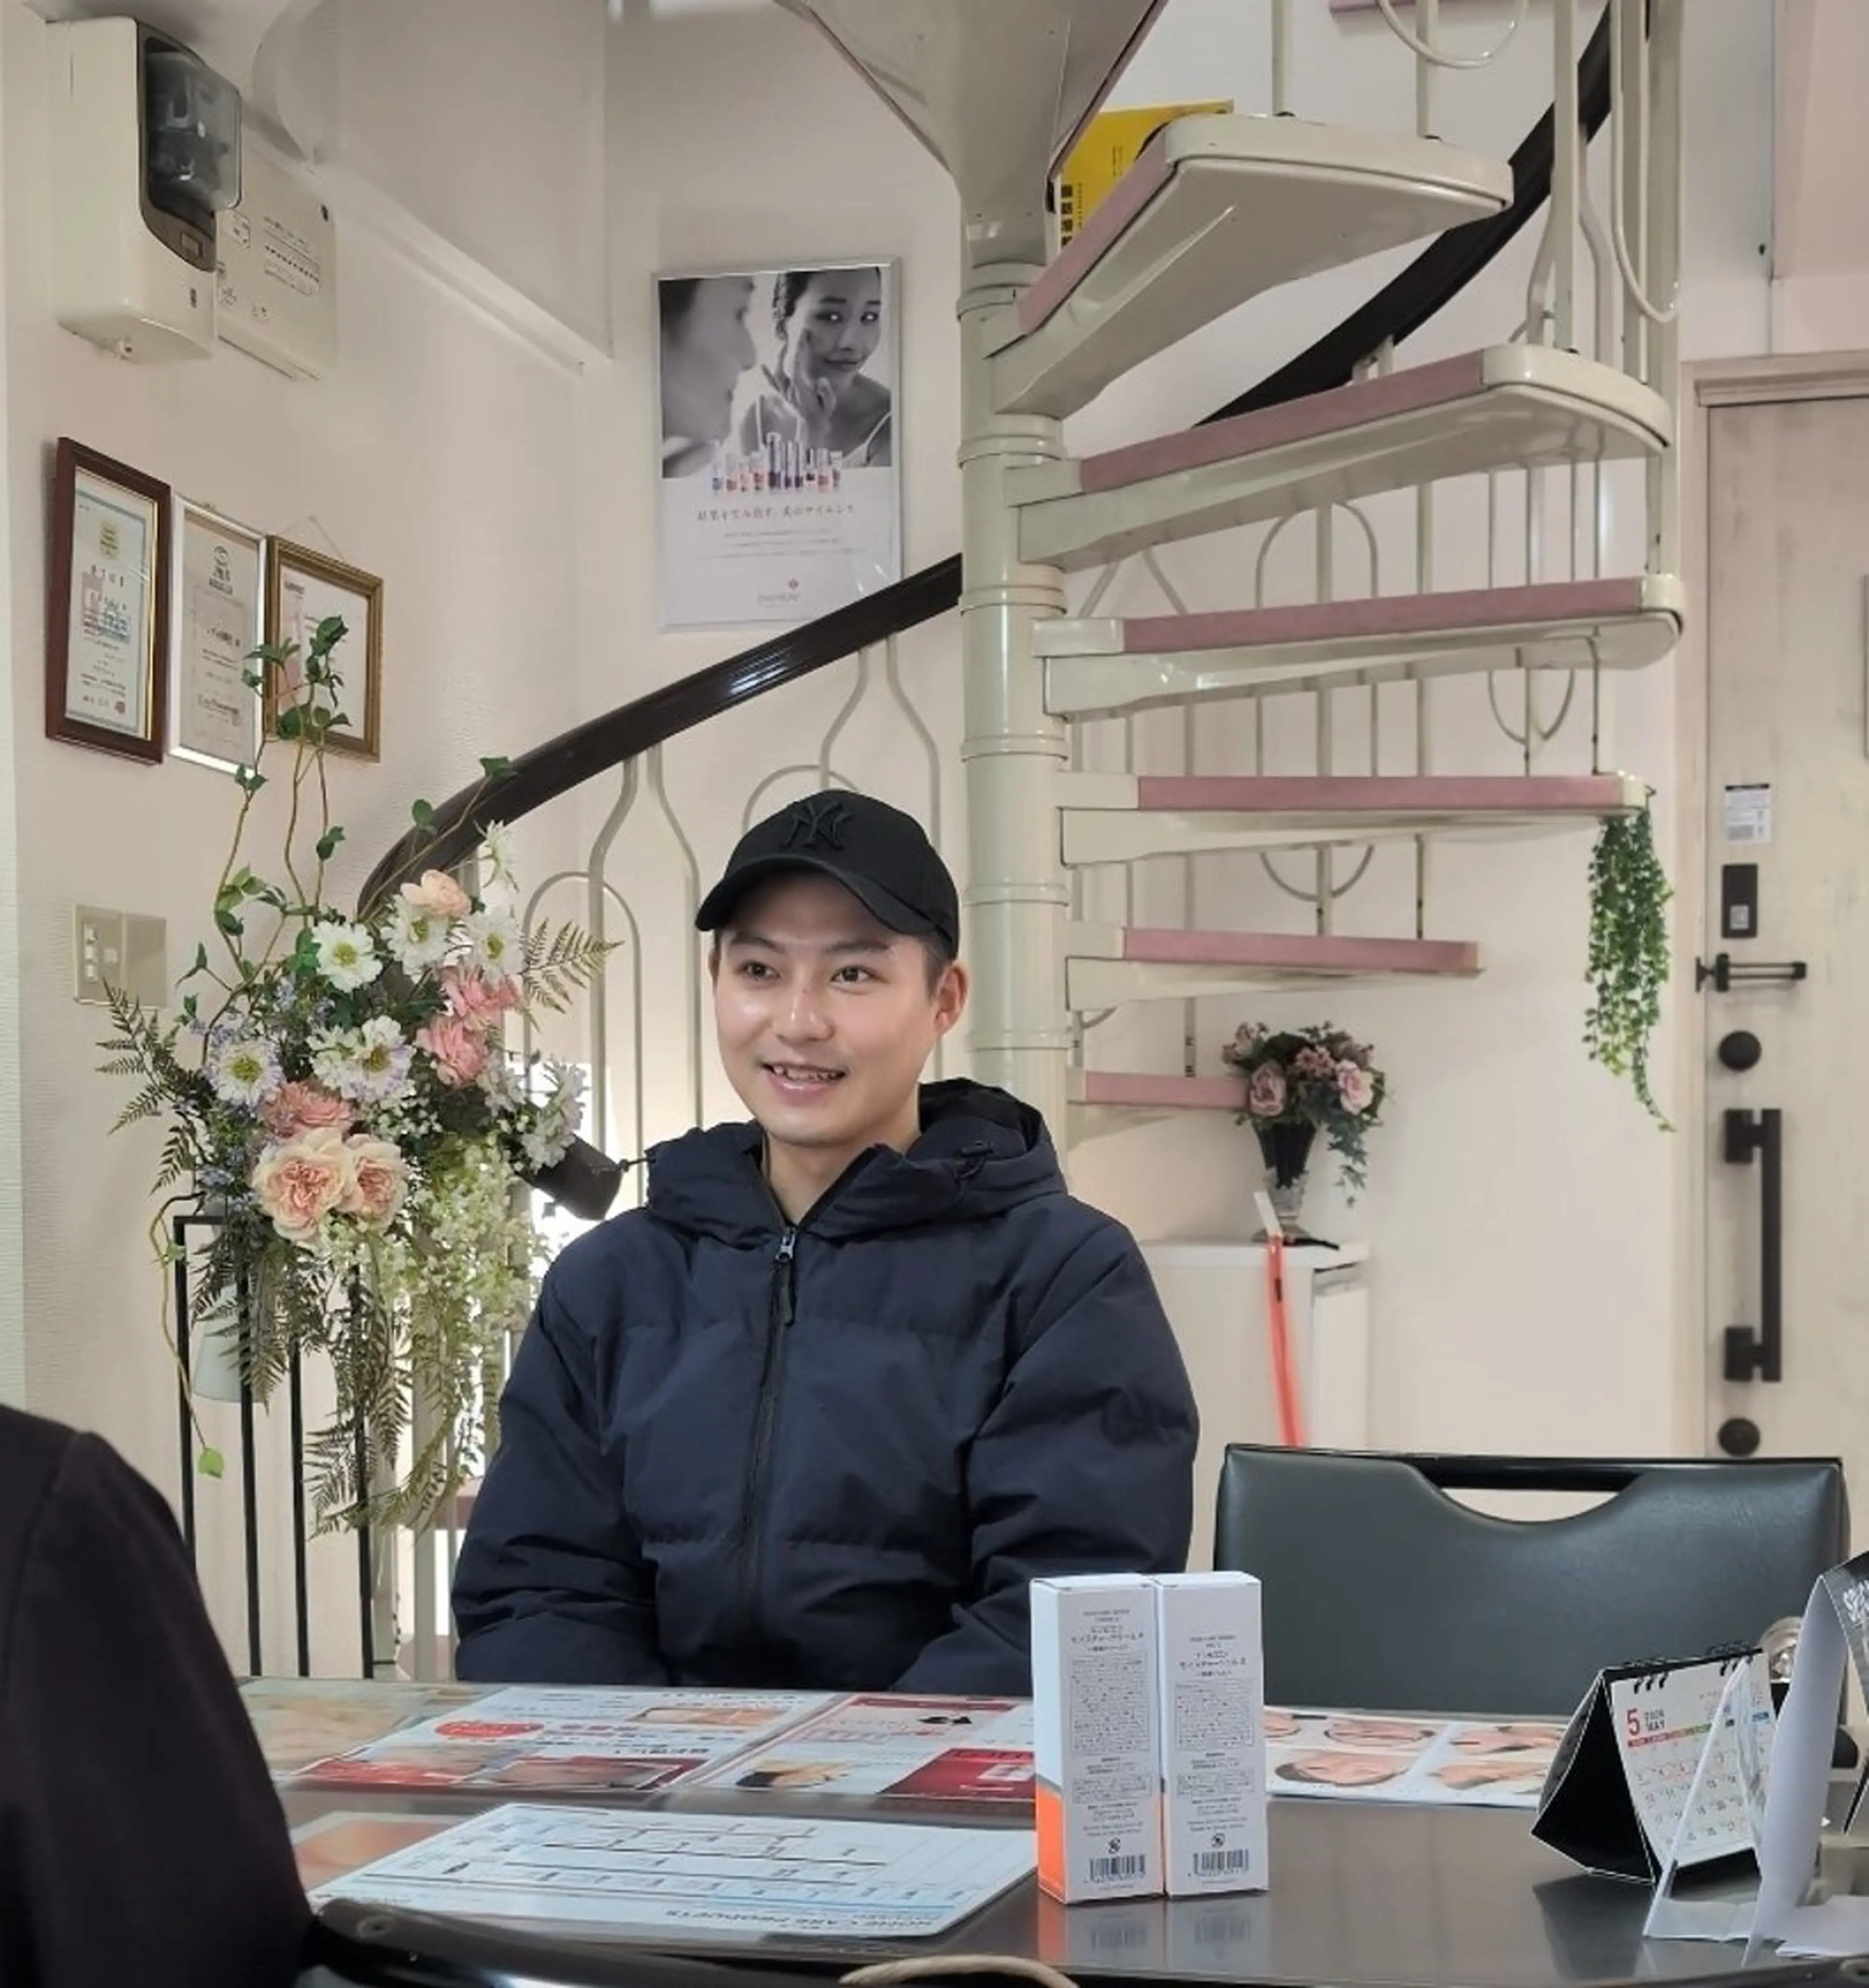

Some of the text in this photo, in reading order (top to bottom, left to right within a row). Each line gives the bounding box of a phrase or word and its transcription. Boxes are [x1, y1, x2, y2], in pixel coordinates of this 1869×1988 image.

[784, 799, 853, 849] NY
[1626, 1708, 1641, 1736] 5
[1646, 1719, 1665, 1731] MAY
